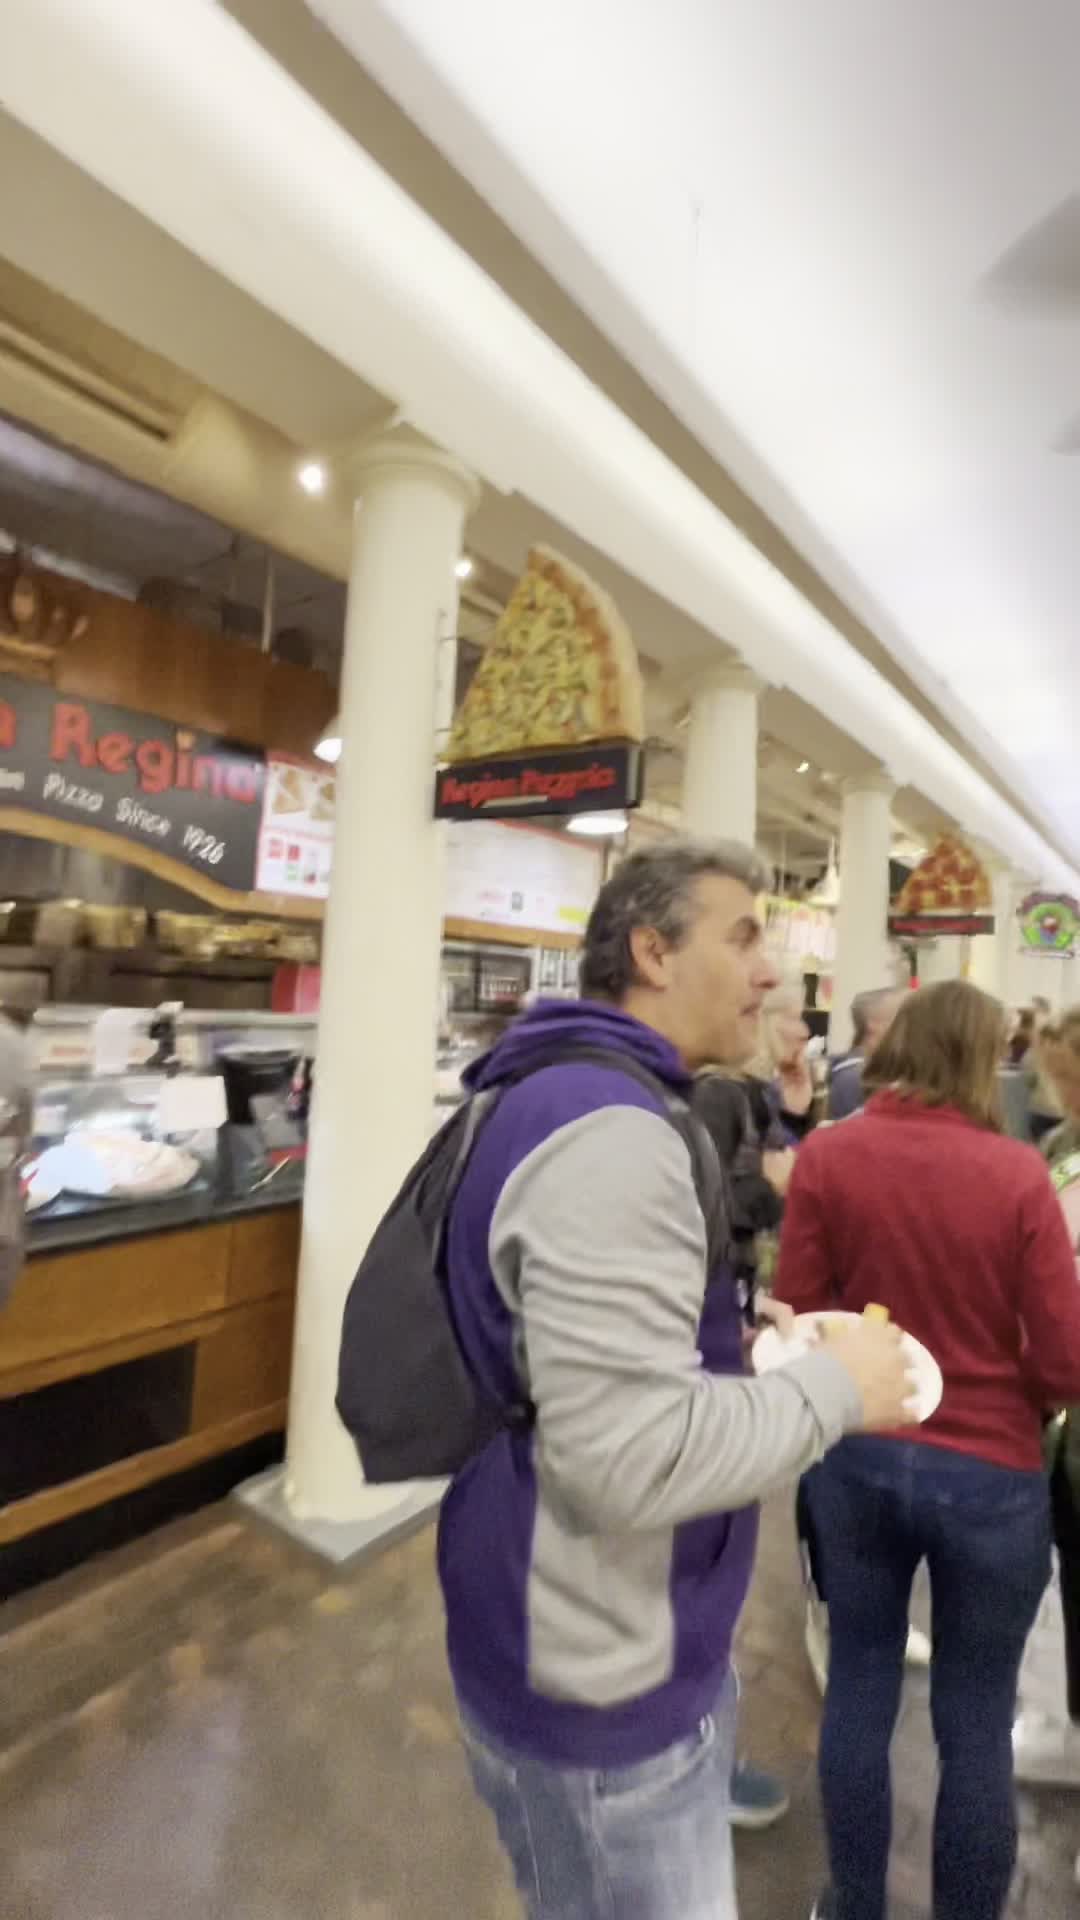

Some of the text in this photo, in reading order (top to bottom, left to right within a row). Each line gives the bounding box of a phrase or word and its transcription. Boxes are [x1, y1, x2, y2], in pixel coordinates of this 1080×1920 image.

[49, 702, 258, 804] Regina
[42, 772, 104, 813] Pizza
[115, 797, 171, 838] Since
[182, 826, 227, 865] 1926
